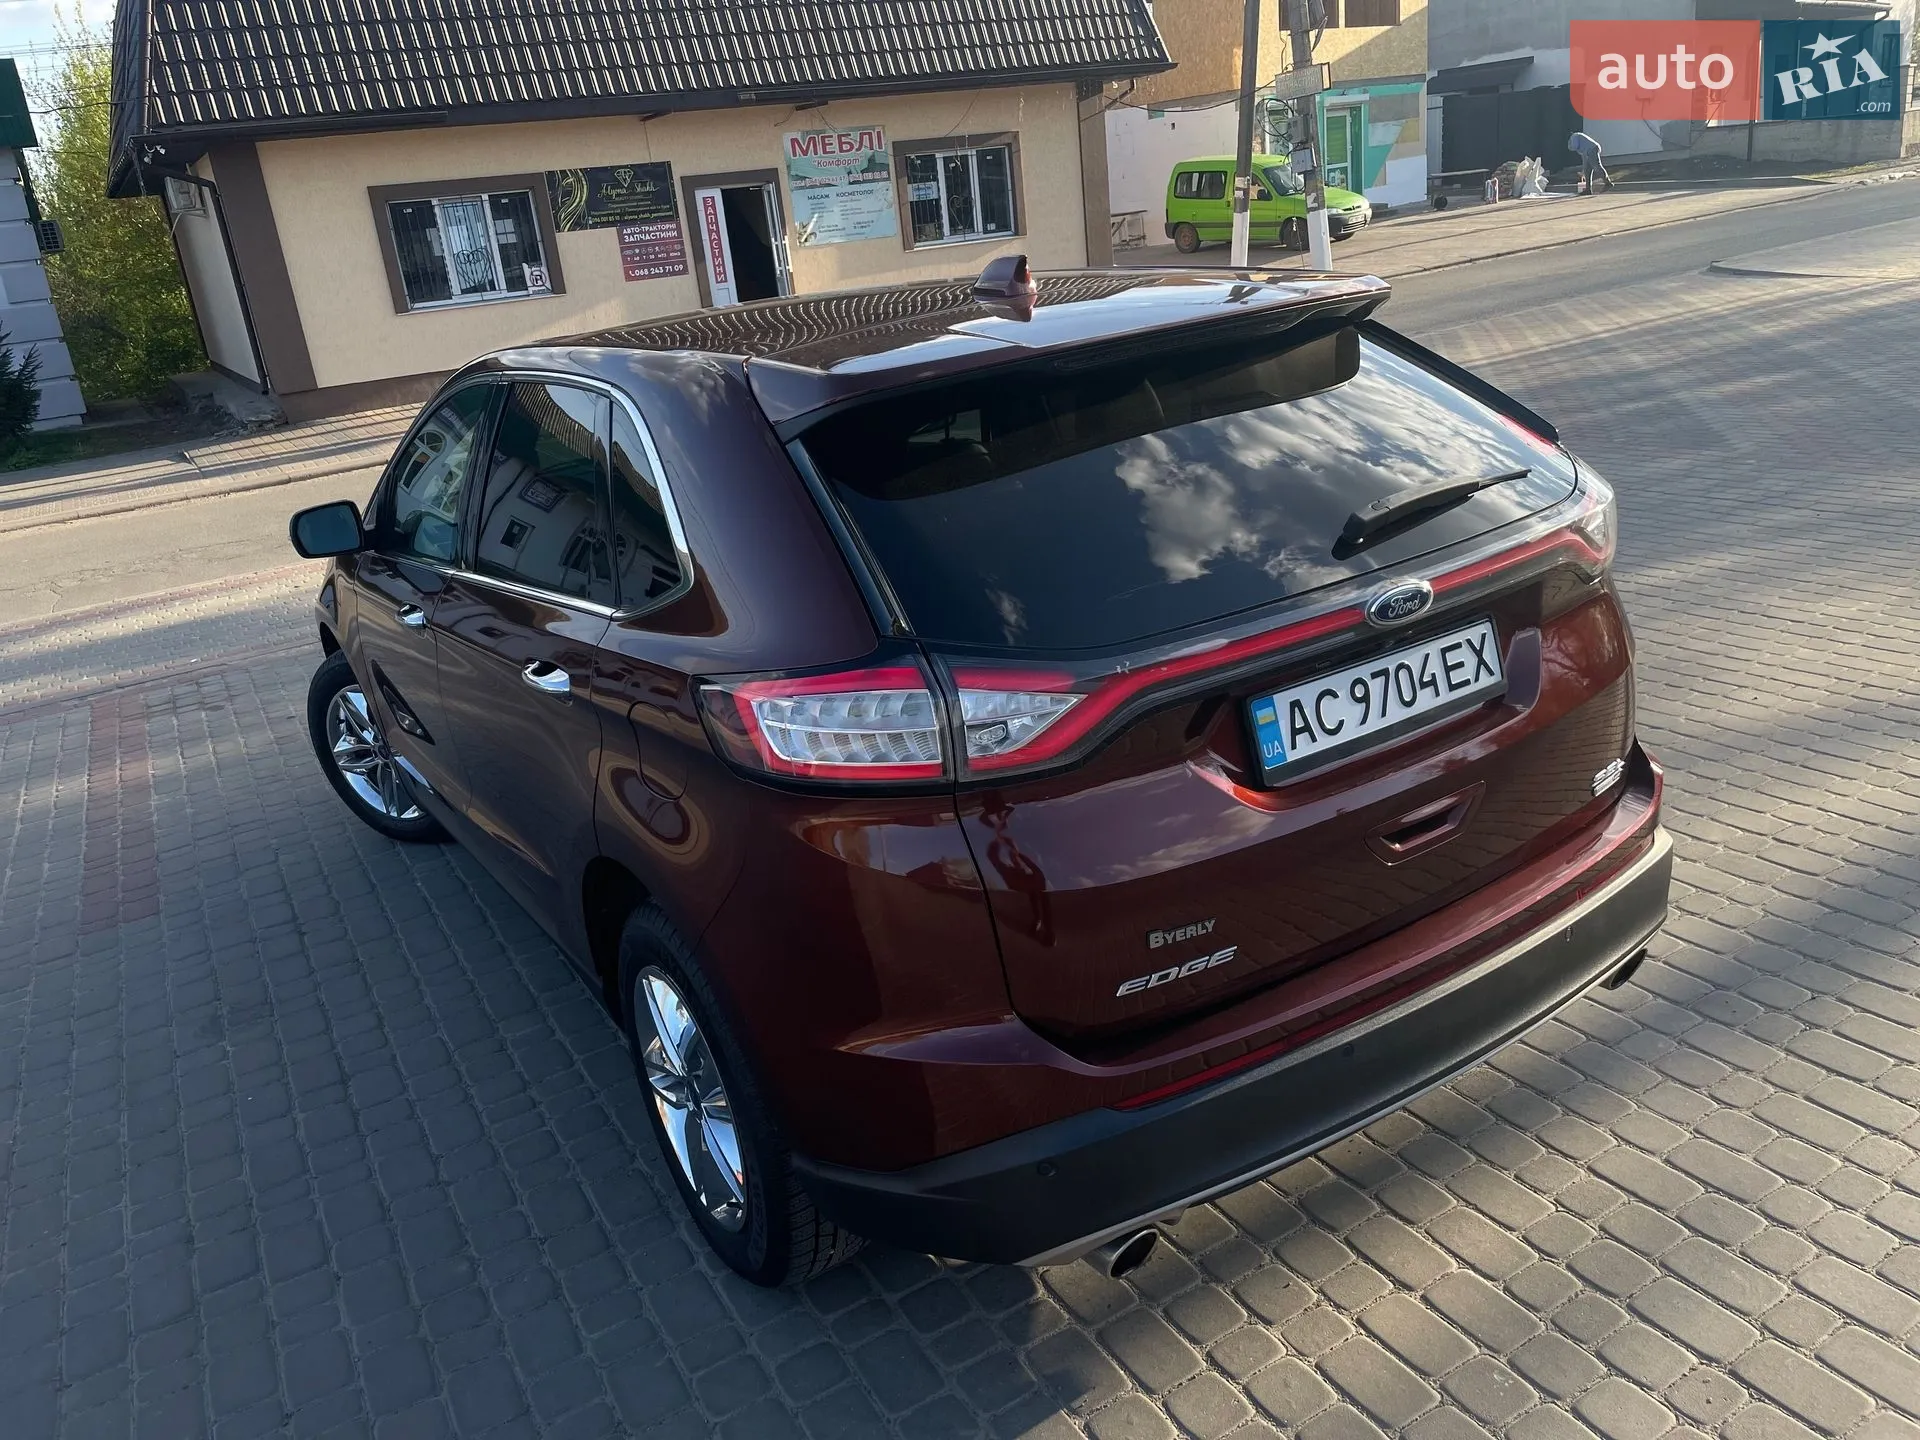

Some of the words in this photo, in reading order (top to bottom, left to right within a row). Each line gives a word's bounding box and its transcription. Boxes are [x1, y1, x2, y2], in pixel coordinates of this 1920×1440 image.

[789, 129, 884, 158] МЕБЛІ
[807, 193, 830, 201] МАСАЖ
[835, 188, 874, 198] КОСМЕТОЛОГ
[622, 223, 677, 235] АВТО-ТРАКТОРНІ
[623, 230, 678, 243] ЗАПЧАСТИНИ
[705, 197, 725, 282] ЗАПЧАСТИНИ
[634, 268, 649, 276] 068
[649, 266, 664, 275] 243
[673, 264, 684, 272] 09
[1388, 592, 1421, 618] Ford
[1263, 742, 1283, 758] UA
[1289, 688, 1345, 750] AC
[1349, 632, 1495, 727] 9704EX
[1149, 918, 1217, 949] BYERLY
[1116, 945, 1238, 997] EDGE
